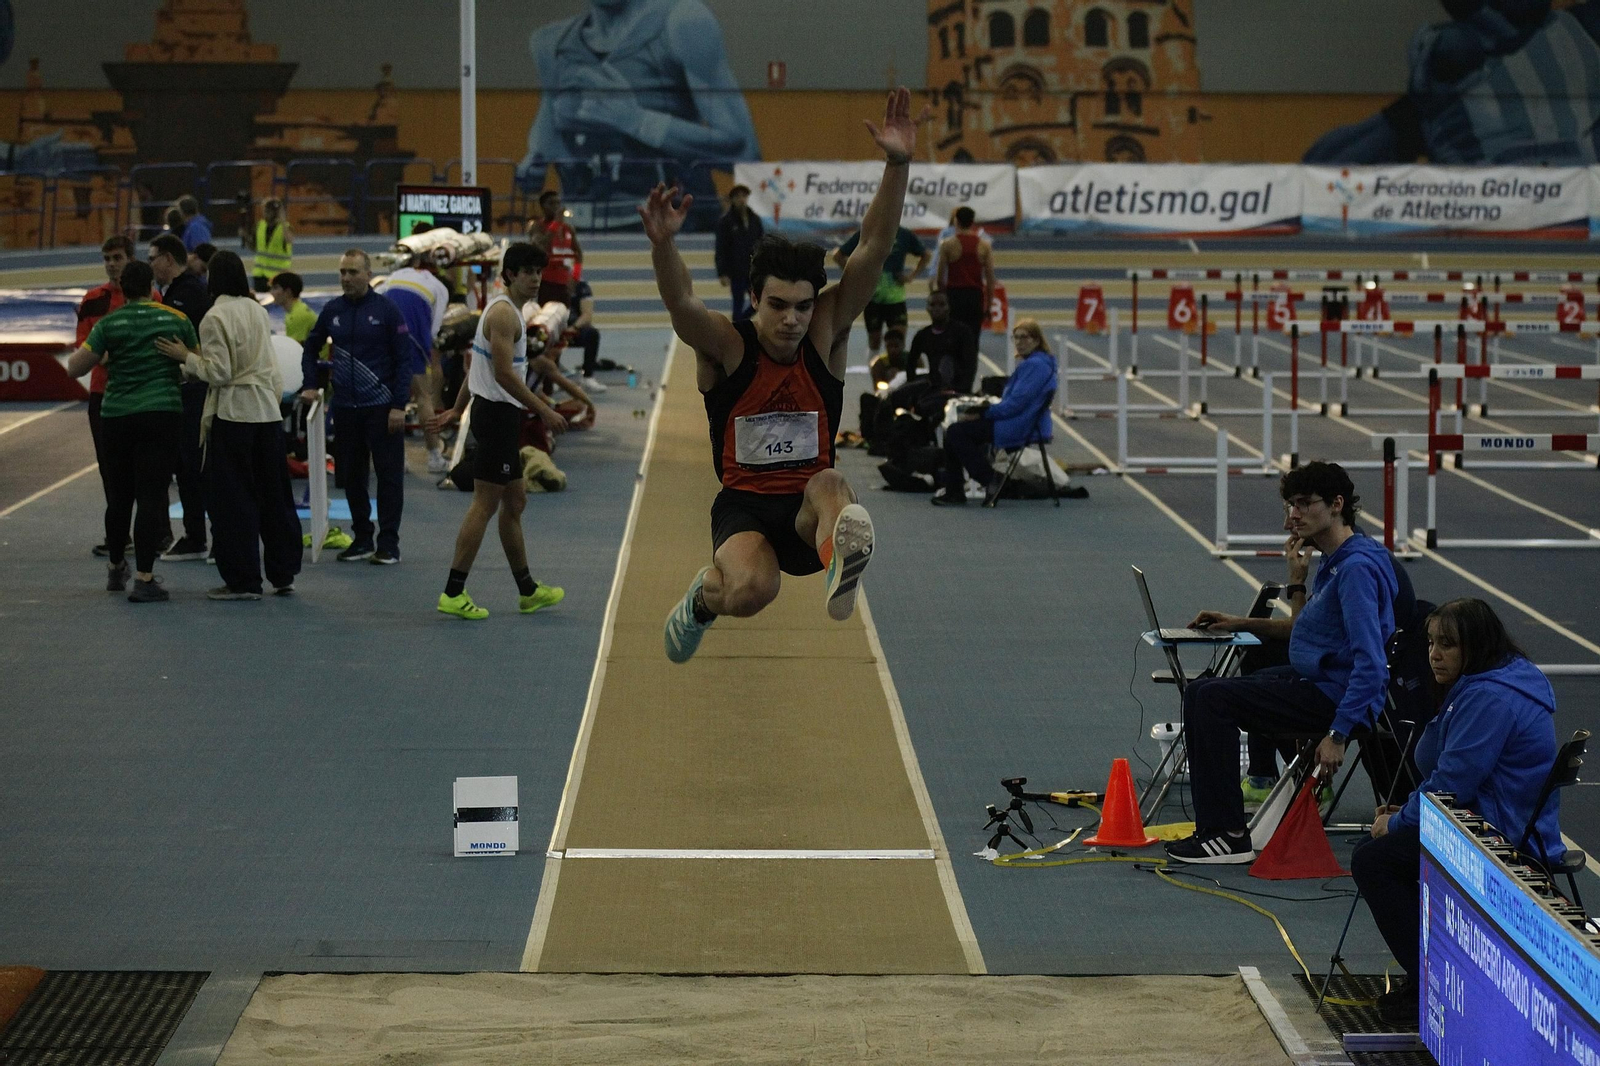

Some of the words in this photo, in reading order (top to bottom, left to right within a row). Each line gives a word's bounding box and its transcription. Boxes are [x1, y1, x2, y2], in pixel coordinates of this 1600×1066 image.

[804, 172, 880, 195] Federac
[908, 176, 988, 202] Galega
[1373, 175, 1476, 196] Federación
[1481, 177, 1562, 203] Galega
[399, 194, 406, 212] J
[406, 194, 449, 213] MARTINEZ
[449, 194, 482, 214] GARCIA
[804, 201, 825, 217] de
[1049, 181, 1273, 222] atletismo.gal
[1373, 204, 1394, 218] de
[1401, 199, 1501, 221] Atletismo
[1083, 297, 1099, 323] 7
[1173, 298, 1192, 323] 6
[1272, 295, 1290, 324] 5
[1563, 301, 1581, 324] 2
[765, 440, 794, 456] 143
[1481, 438, 1534, 448] MONDO
[1501, 955, 1529, 1020] ARROJO
[1531, 981, 1557, 1054] (RZCC)
